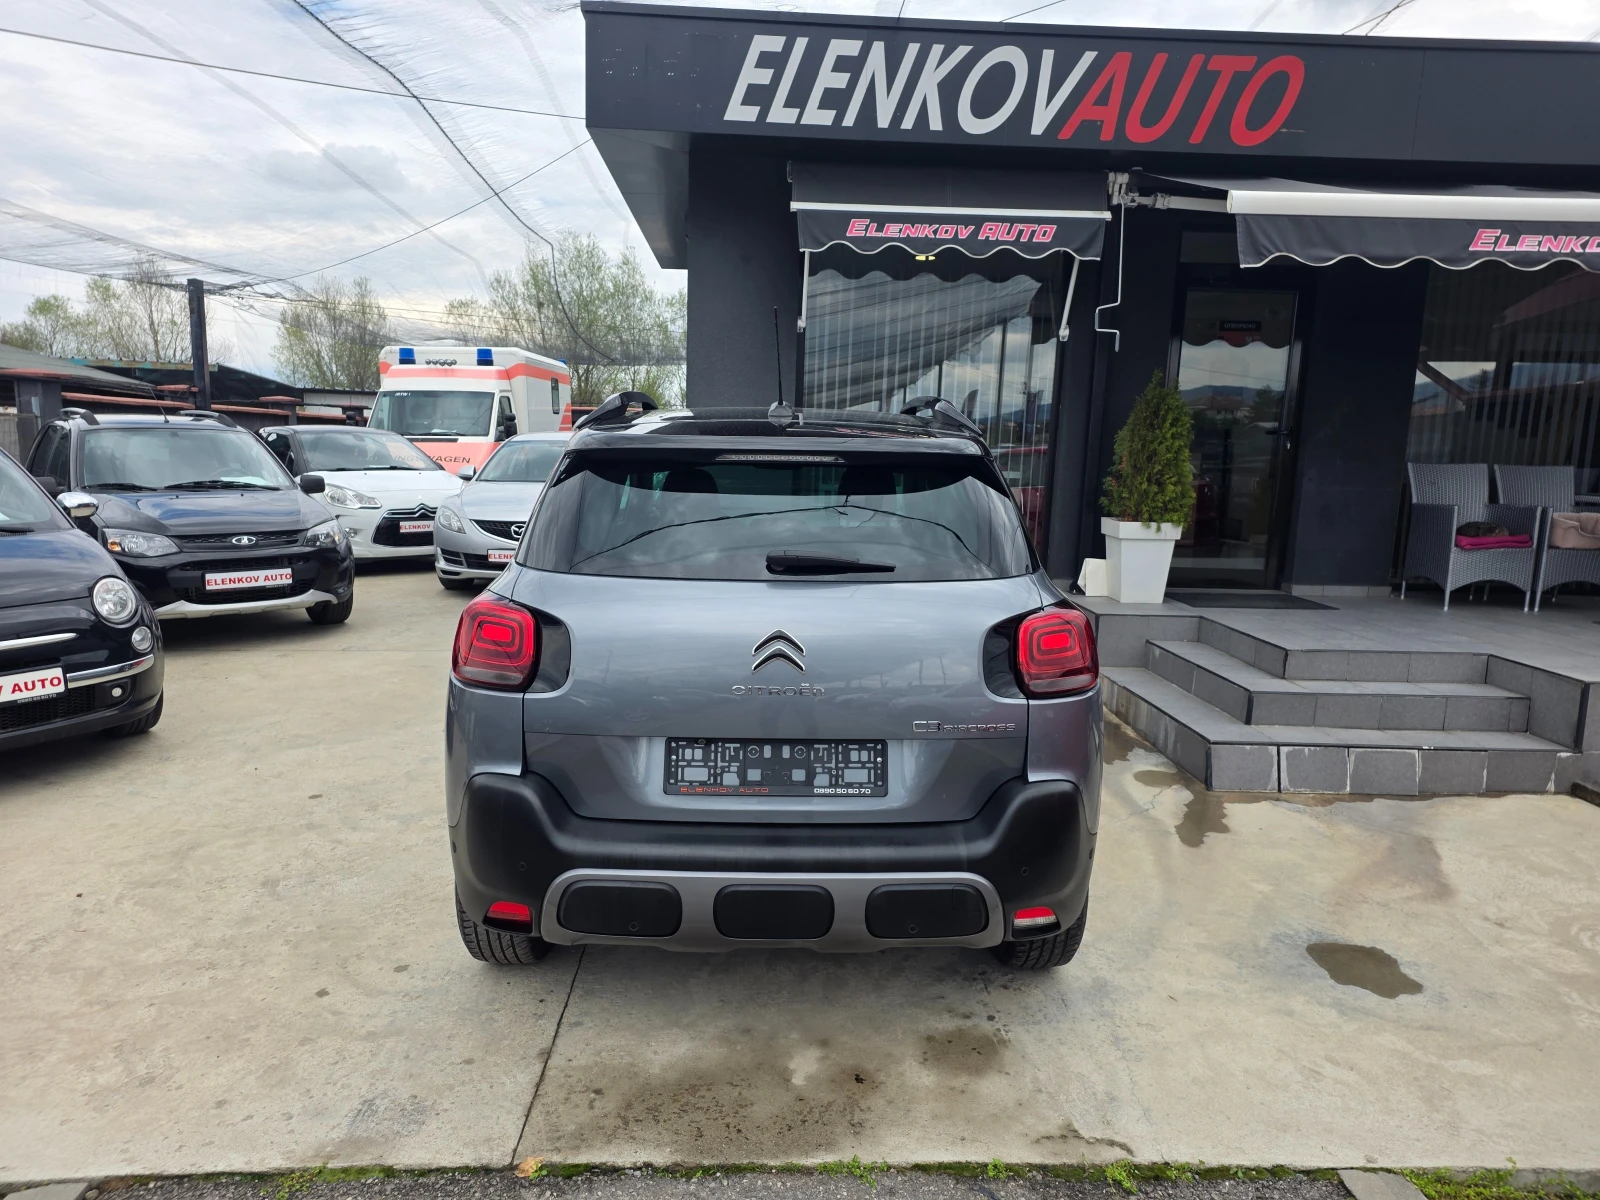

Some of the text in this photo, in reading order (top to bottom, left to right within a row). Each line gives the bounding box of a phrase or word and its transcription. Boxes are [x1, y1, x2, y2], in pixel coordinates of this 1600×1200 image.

[846, 218, 1057, 243] ELENKOV AUTO
[400, 523, 431, 531] ELENKOV
[206, 573, 292, 586] ELENKOV AUTO
[11, 676, 62, 694] AUTO
[731, 682, 825, 696] CITROËN
[912, 720, 1016, 732] C3 AIRCROSS
